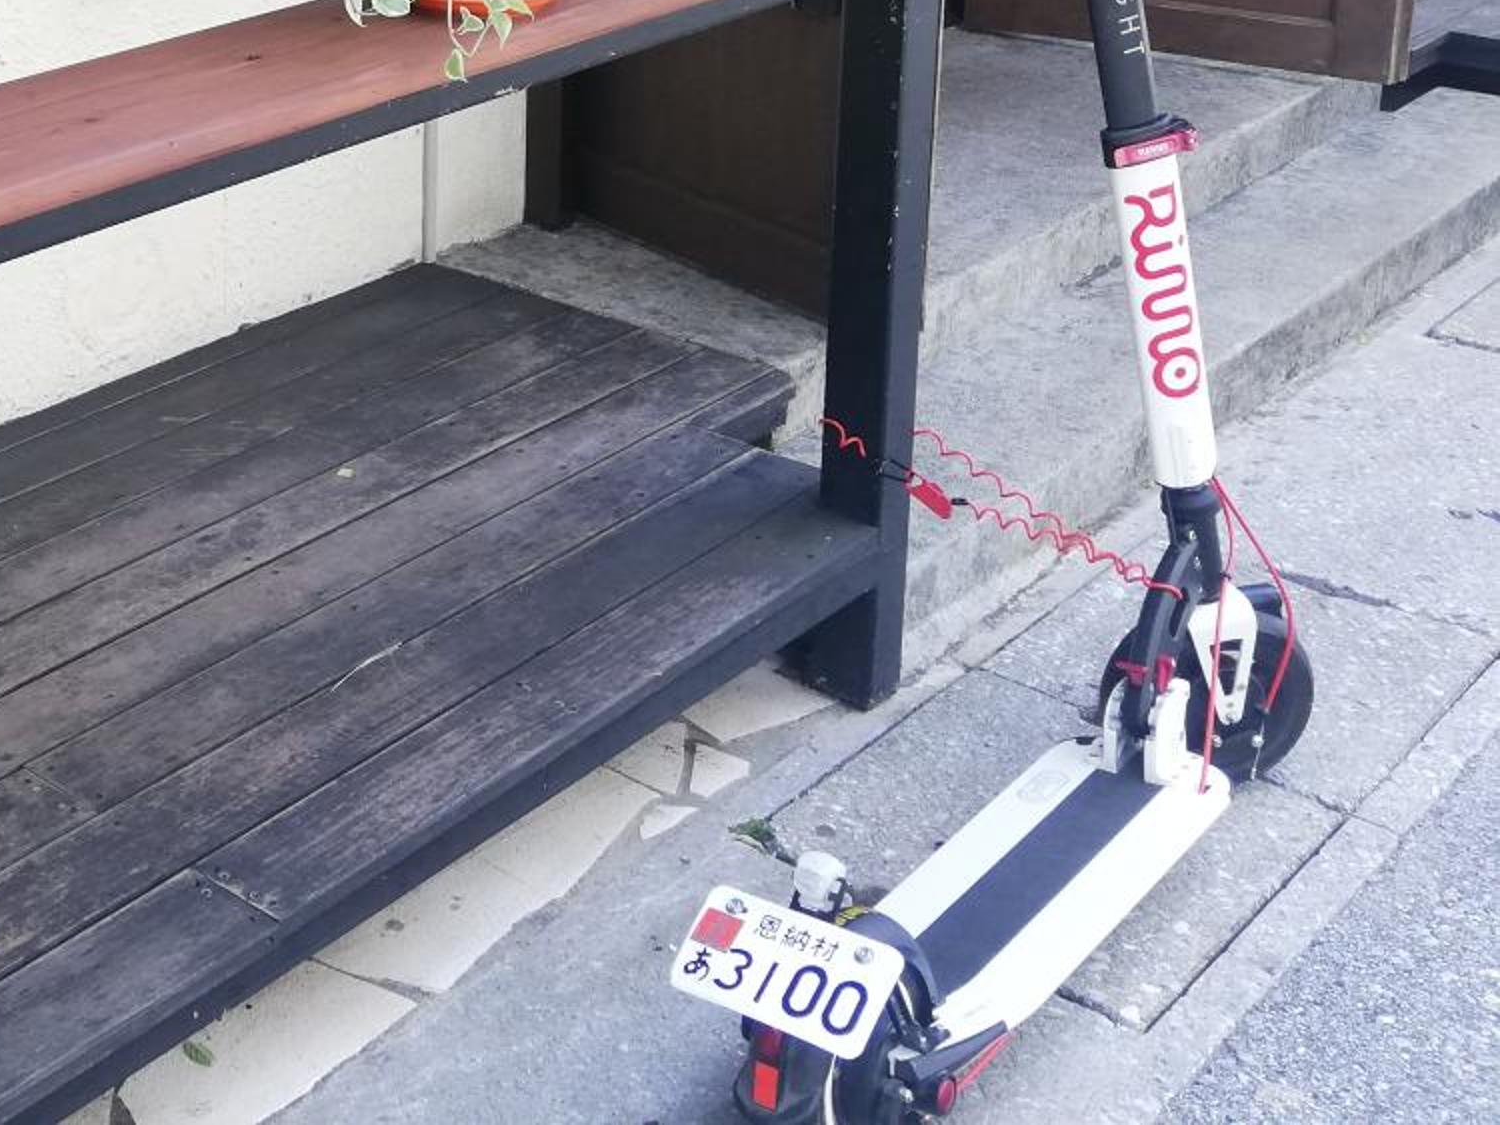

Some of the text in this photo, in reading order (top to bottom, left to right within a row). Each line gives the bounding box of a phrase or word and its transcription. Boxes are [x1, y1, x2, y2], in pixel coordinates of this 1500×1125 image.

[753, 914, 839, 962] 恩納村
[683, 948, 869, 1036] あ 3100
